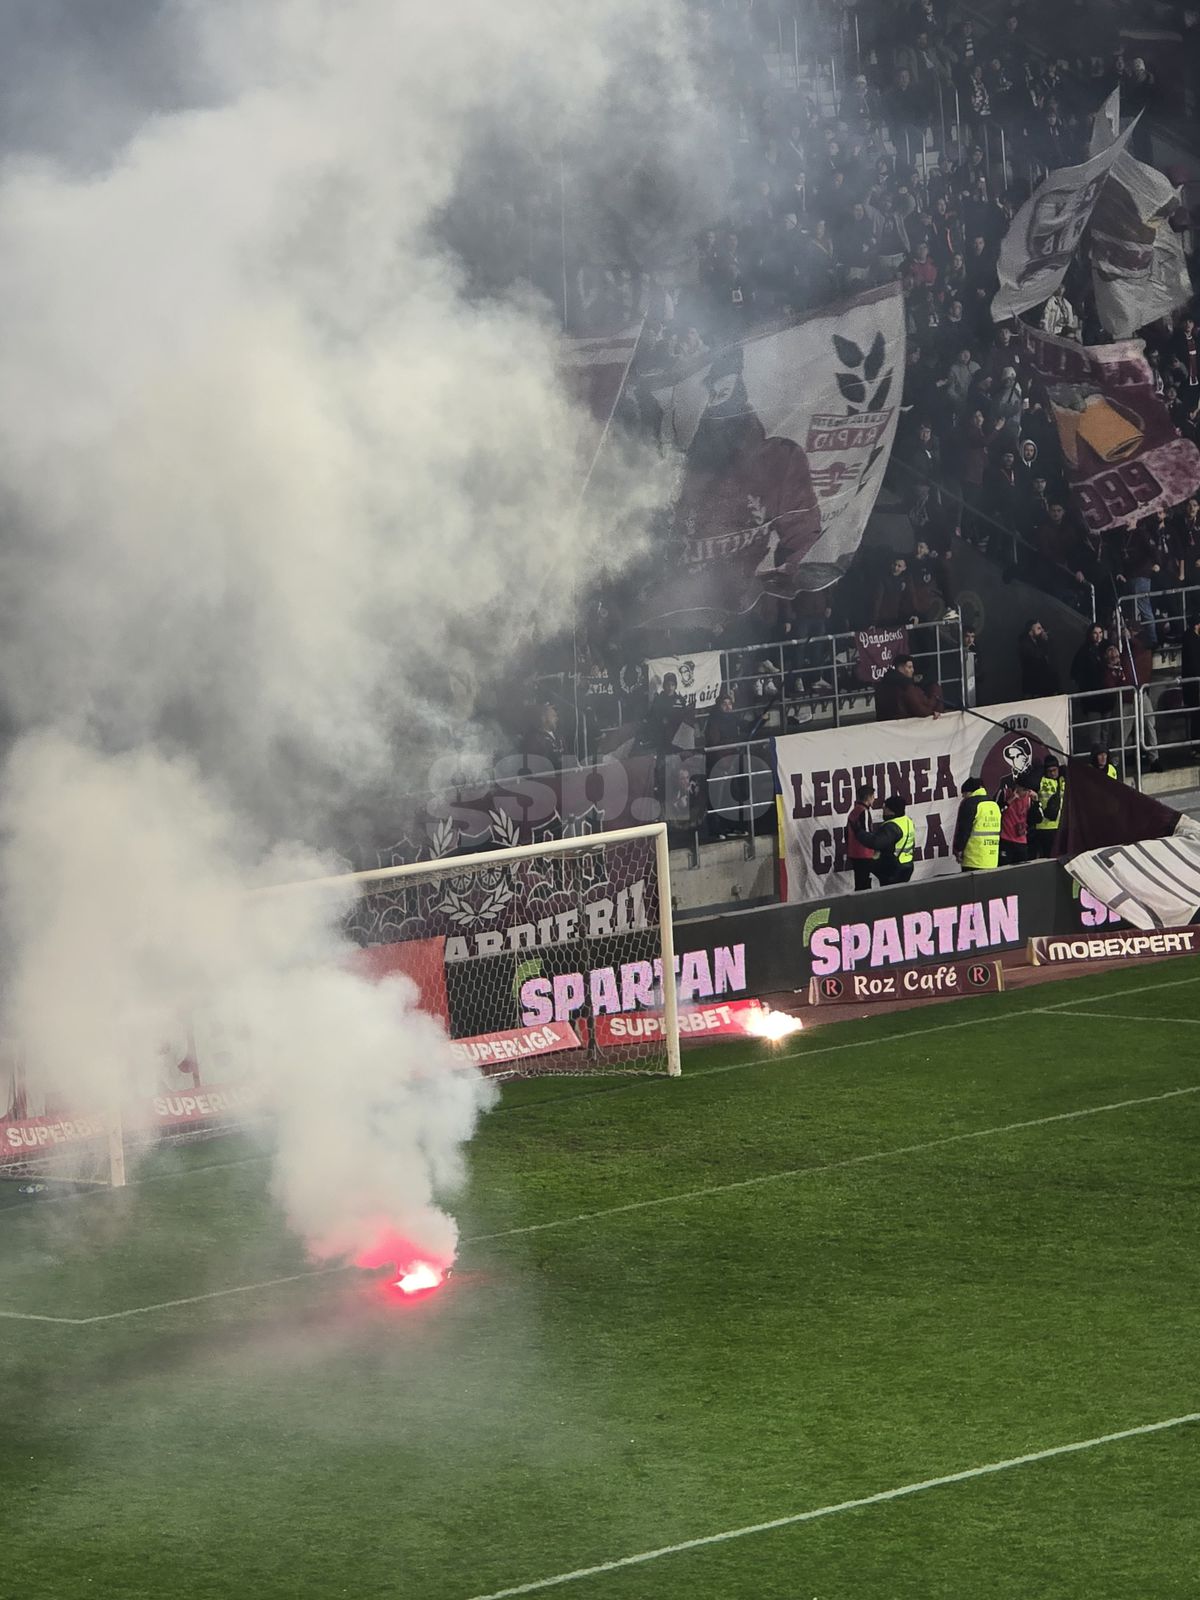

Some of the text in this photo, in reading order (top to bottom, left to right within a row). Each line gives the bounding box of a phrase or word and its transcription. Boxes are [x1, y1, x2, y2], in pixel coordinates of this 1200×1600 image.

[881, 646, 892, 661] de
[1003, 717, 1029, 733] 2010
[791, 754, 958, 820] LEGHINEA
[810, 895, 1020, 976] SPARTAN
[1049, 932, 1195, 961] MOBEXPERT
[519, 943, 747, 1027] SPARTAN
[854, 975, 895, 996] Roz
[904, 965, 958, 992] Café
[450, 1026, 561, 1061] SUPERLIGA
